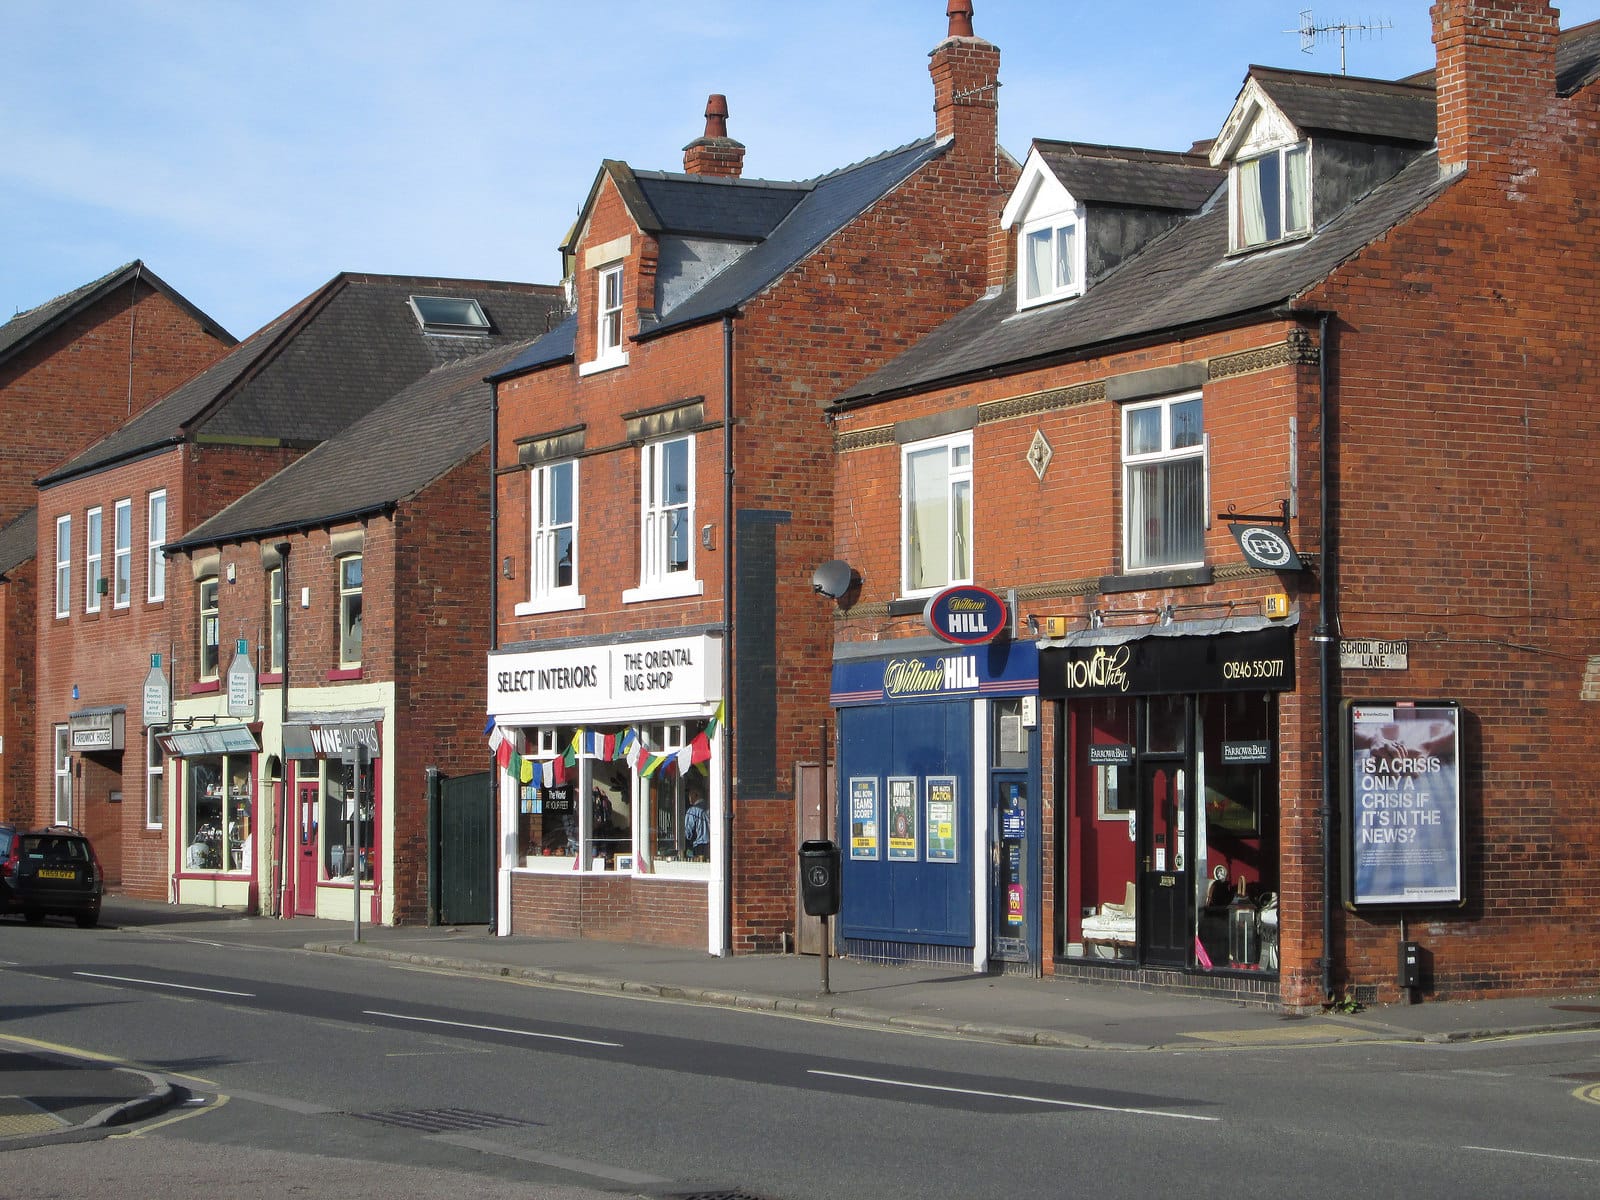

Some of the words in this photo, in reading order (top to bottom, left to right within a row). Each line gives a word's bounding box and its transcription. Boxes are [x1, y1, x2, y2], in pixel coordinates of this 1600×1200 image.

[949, 597, 987, 611] William
[948, 613, 988, 633] HILL
[1341, 642, 1374, 654] SCHOOL
[1378, 642, 1407, 655] BOARD
[624, 653, 644, 671] THE
[645, 648, 694, 669] ORIENTAL
[1362, 655, 1390, 668] LANE.
[884, 657, 946, 695] William
[944, 655, 980, 690] HILL
[1223, 661, 1252, 679] 01246
[1253, 660, 1284, 678] 550777
[497, 670, 535, 693] SELECT
[538, 665, 598, 691] INTERIORS
[624, 673, 644, 691] RUG
[646, 671, 674, 691] SHOP
[310, 726, 378, 753] WINEWORKS
[1361, 757, 1377, 773] IS
[1378, 758, 1390, 773] A
[1391, 757, 1441, 773] CRISIS
[1361, 775, 1402, 791] ONLY
[1403, 775, 1415, 790] A
[854, 798, 873, 810] TEAMS
[932, 791, 951, 801] ACTION
[1361, 792, 1413, 809] CRISIS
[1416, 792, 1430, 808] IF
[1362, 810, 1390, 826] IT'S
[1393, 810, 1407, 825] IN
[1410, 810, 1441, 825] THE
[1362, 828, 1416, 844] NEWS?
